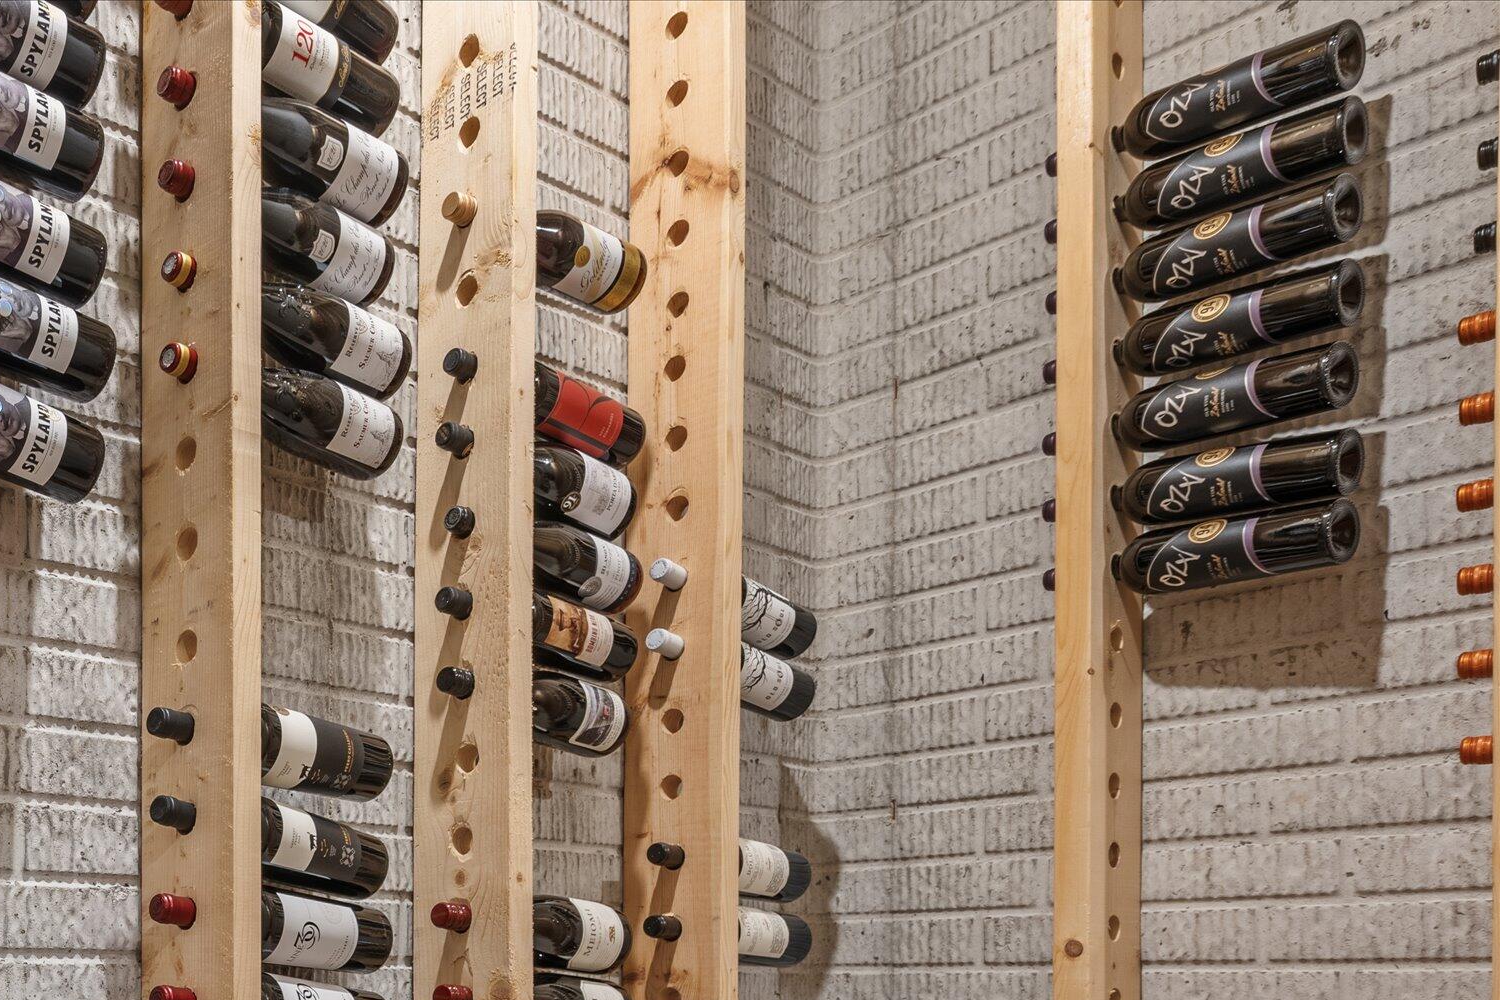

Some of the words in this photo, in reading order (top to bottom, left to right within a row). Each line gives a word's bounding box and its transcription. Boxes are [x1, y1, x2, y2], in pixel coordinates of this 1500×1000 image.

[21, 1, 51, 77] SPYLAND
[291, 20, 315, 68] 120
[460, 73, 471, 120] SELECT
[476, 62, 487, 109] SELECT
[492, 50, 503, 98] SELECT
[28, 89, 49, 153] SPYLAN
[444, 85, 455, 130] SELECT
[41, 300, 62, 358] SPYLAN
[358, 336, 376, 370] SAUMUR
[21, 404, 51, 474] SPYLAND
[353, 417, 369, 448] SAUMUR
[583, 908, 597, 957] MEIOMI
